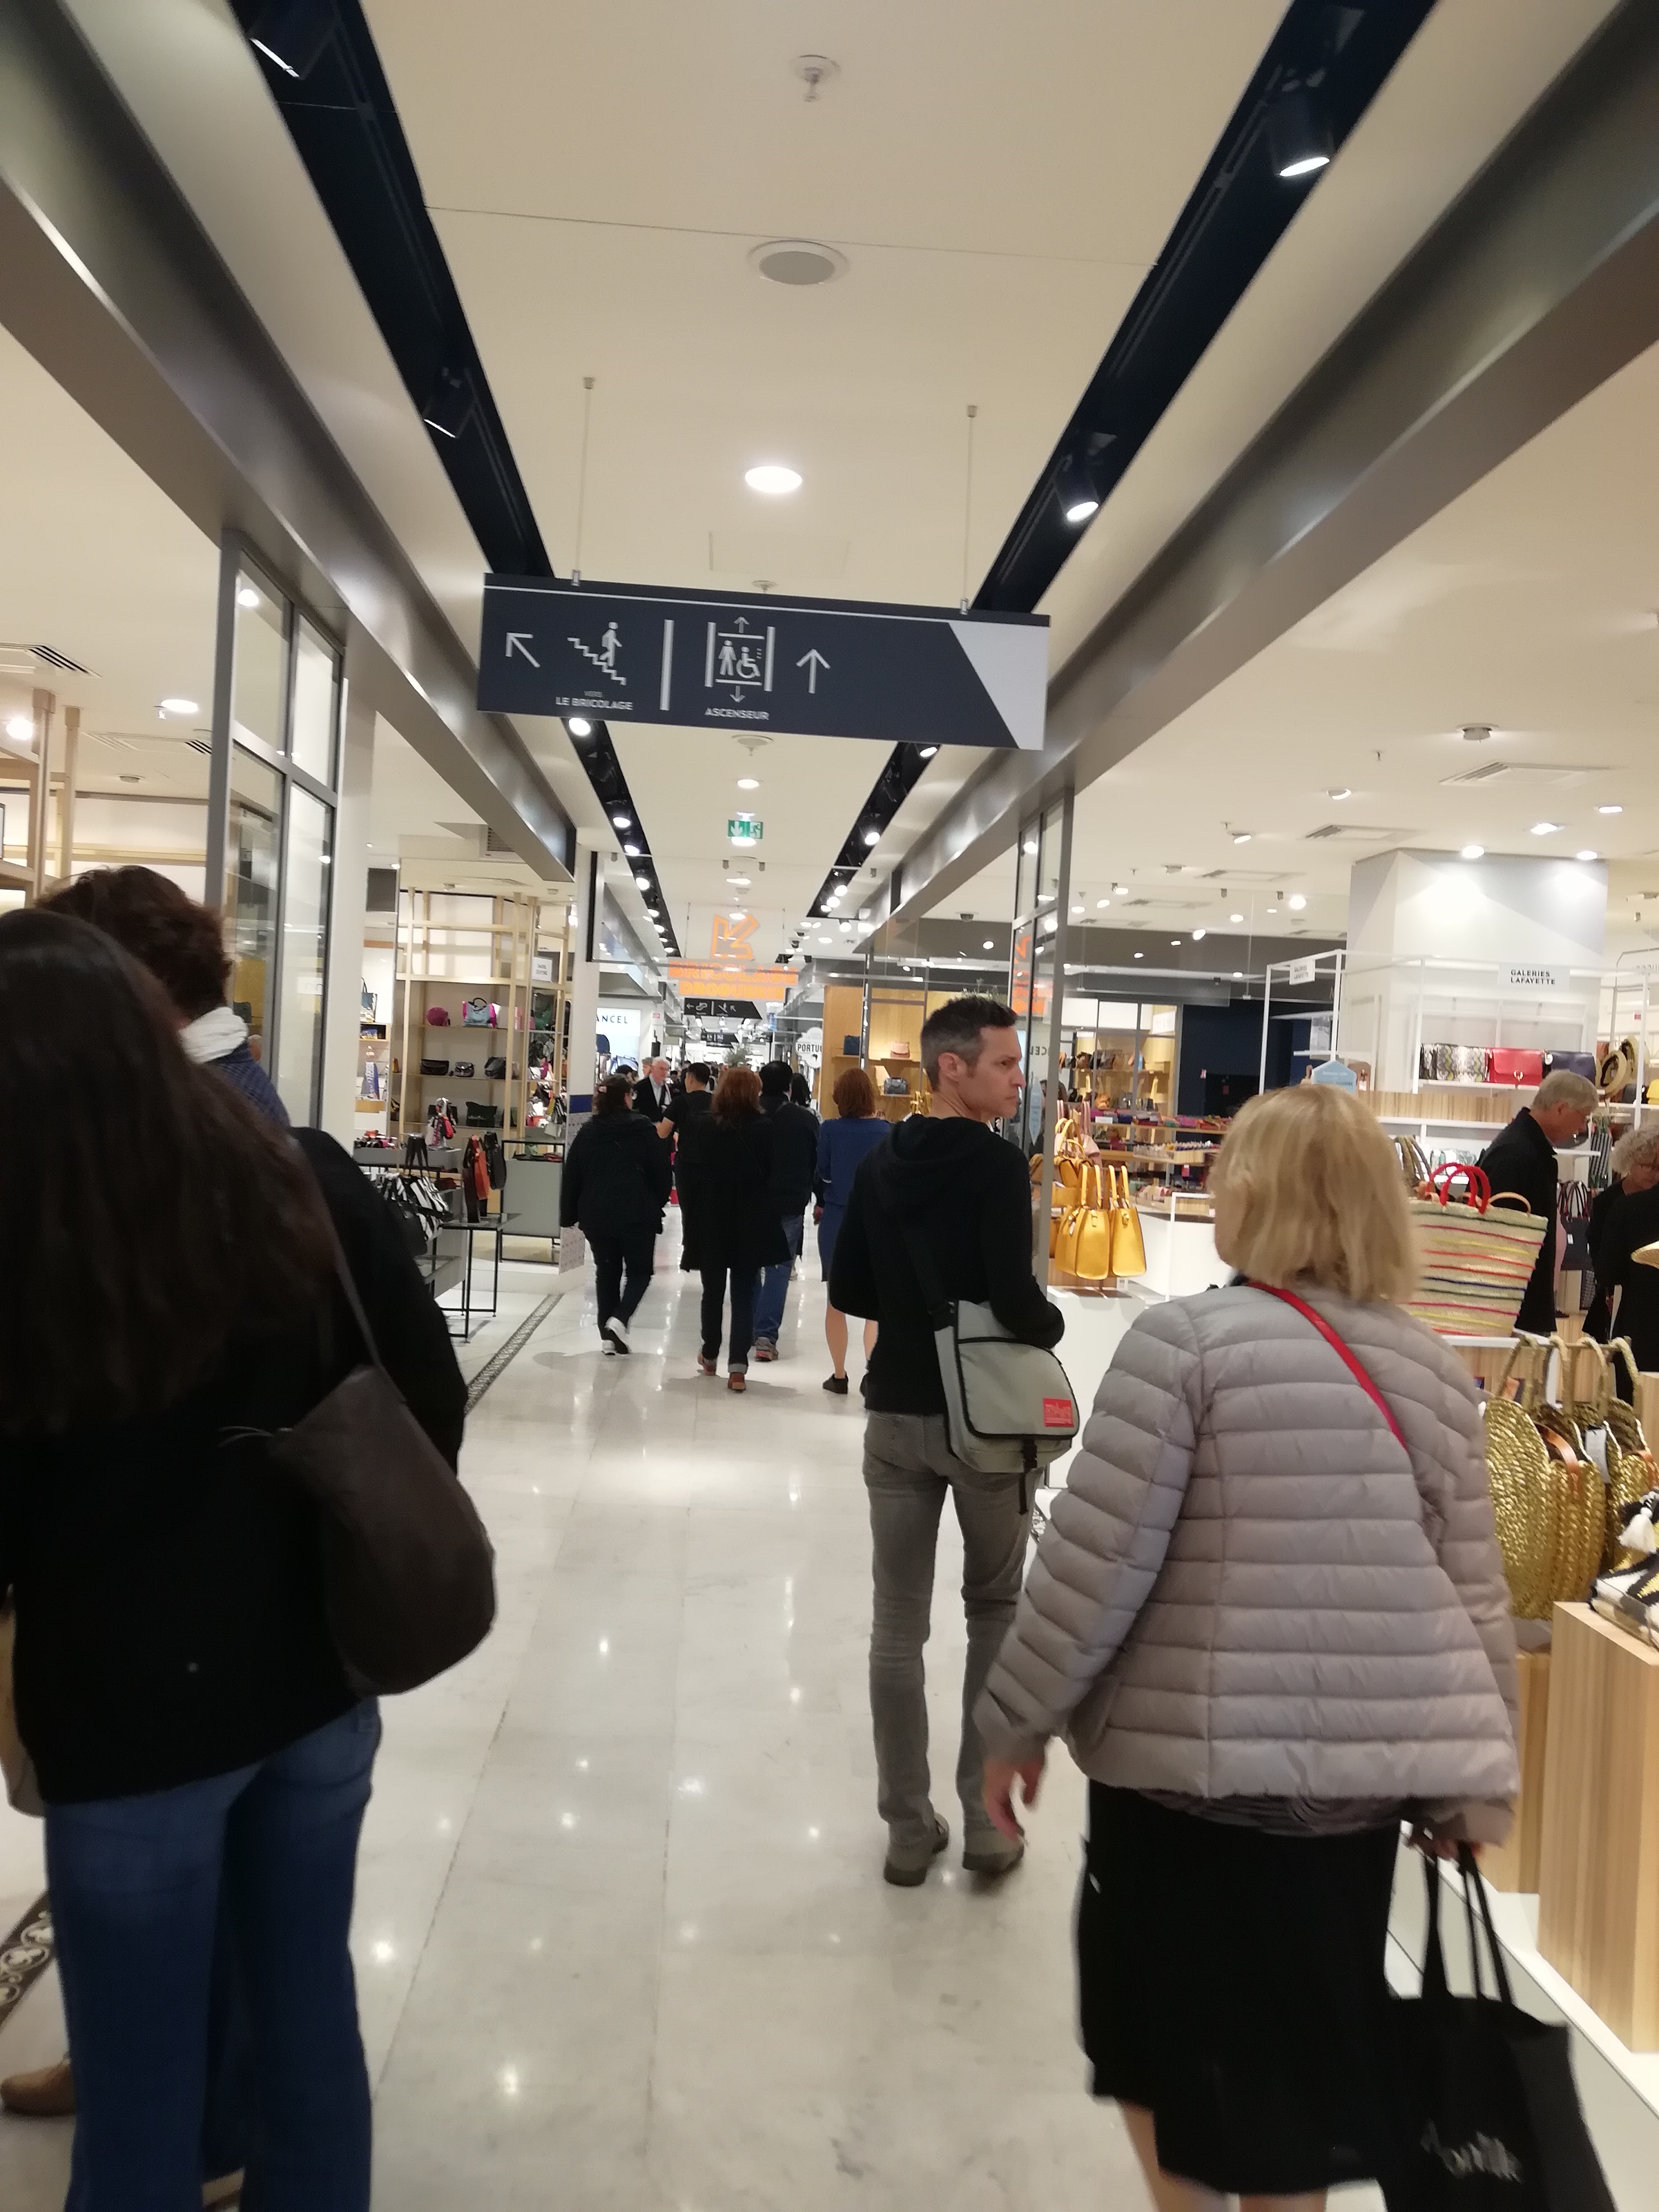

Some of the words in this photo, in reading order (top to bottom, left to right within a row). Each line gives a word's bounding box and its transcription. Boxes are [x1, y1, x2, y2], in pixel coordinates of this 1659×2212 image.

[555, 696, 570, 706] LE
[571, 697, 634, 711] BRICOLAGE
[704, 707, 770, 720] ASCENSEUR
[668, 959, 798, 986] BRICOLAGE
[1510, 969, 1550, 977] GALERIES
[1510, 976, 1556, 986] LAFAYETTE
[679, 980, 785, 1002] DROGUERIE
